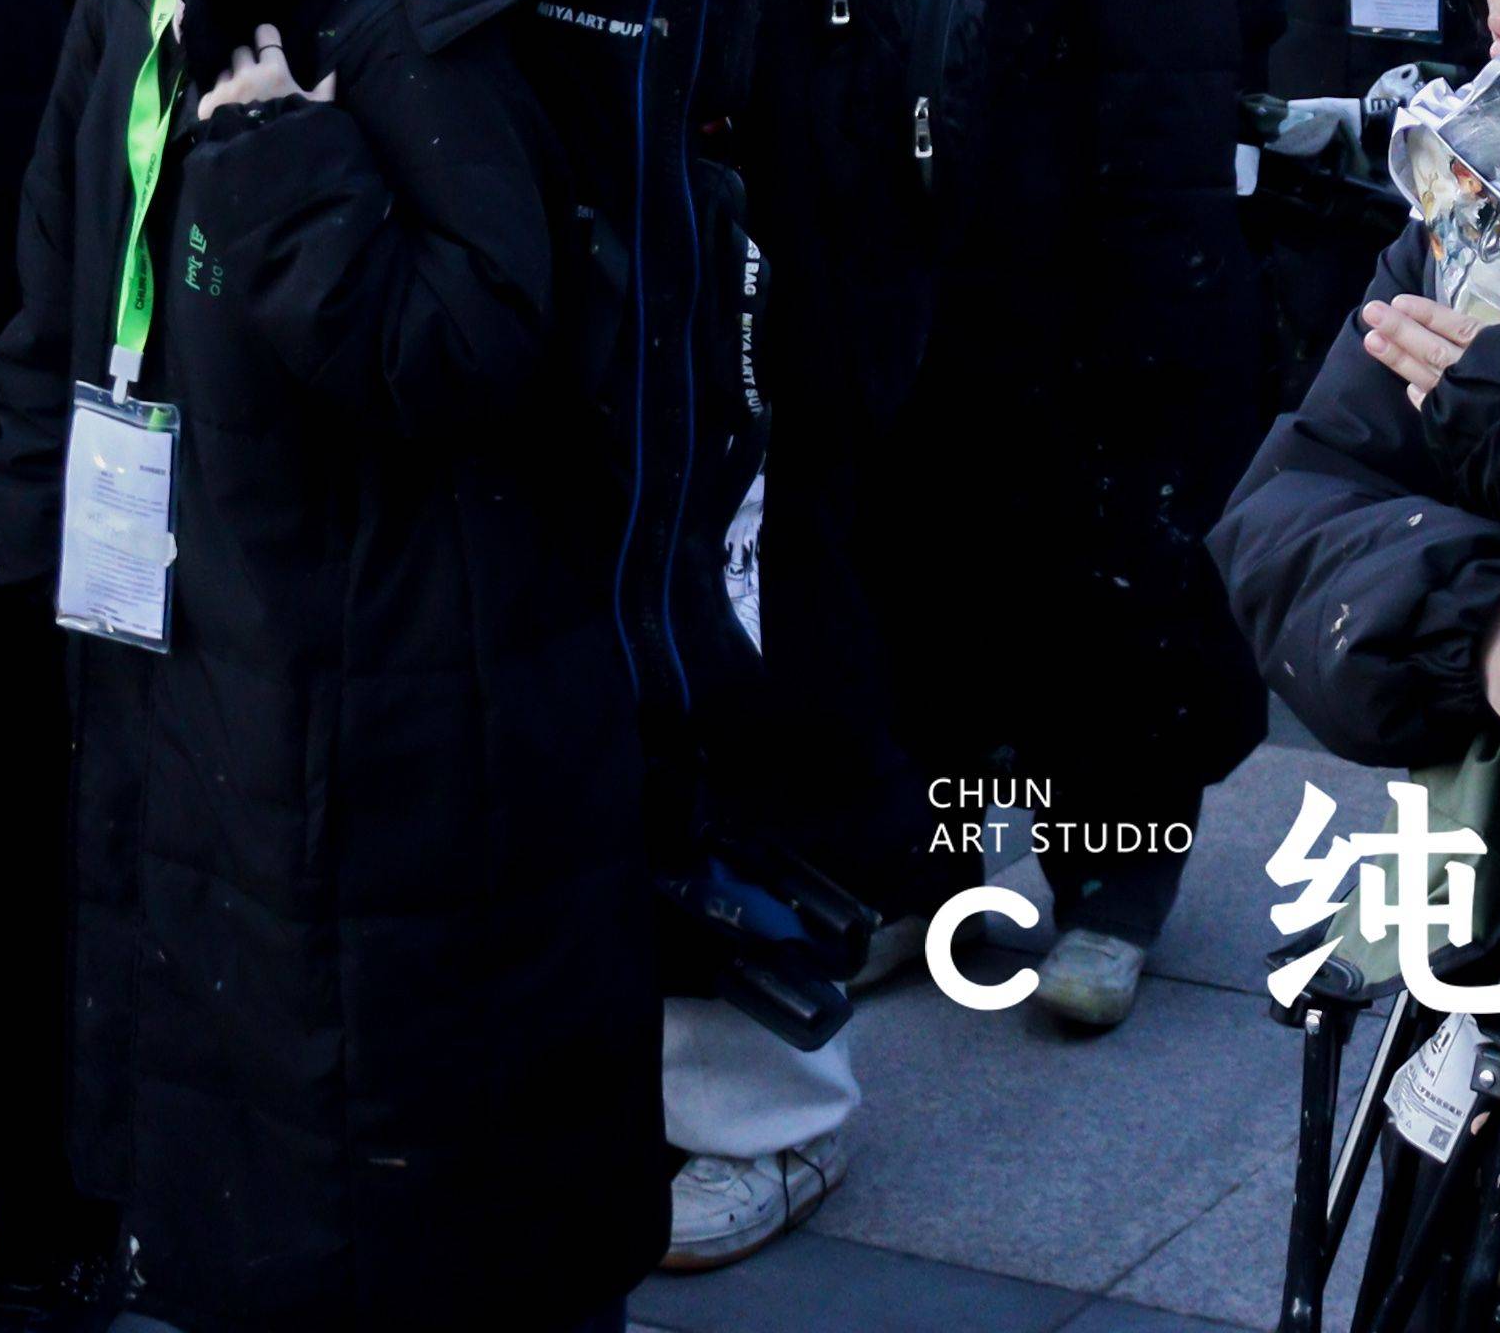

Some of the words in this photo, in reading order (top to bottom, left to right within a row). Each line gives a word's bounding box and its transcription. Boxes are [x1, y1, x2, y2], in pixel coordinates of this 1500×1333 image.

[536, 1, 574, 22] MIYA
[575, 11, 608, 31] ART
[744, 262, 760, 296] BAG
[742, 353, 756, 385] ART
